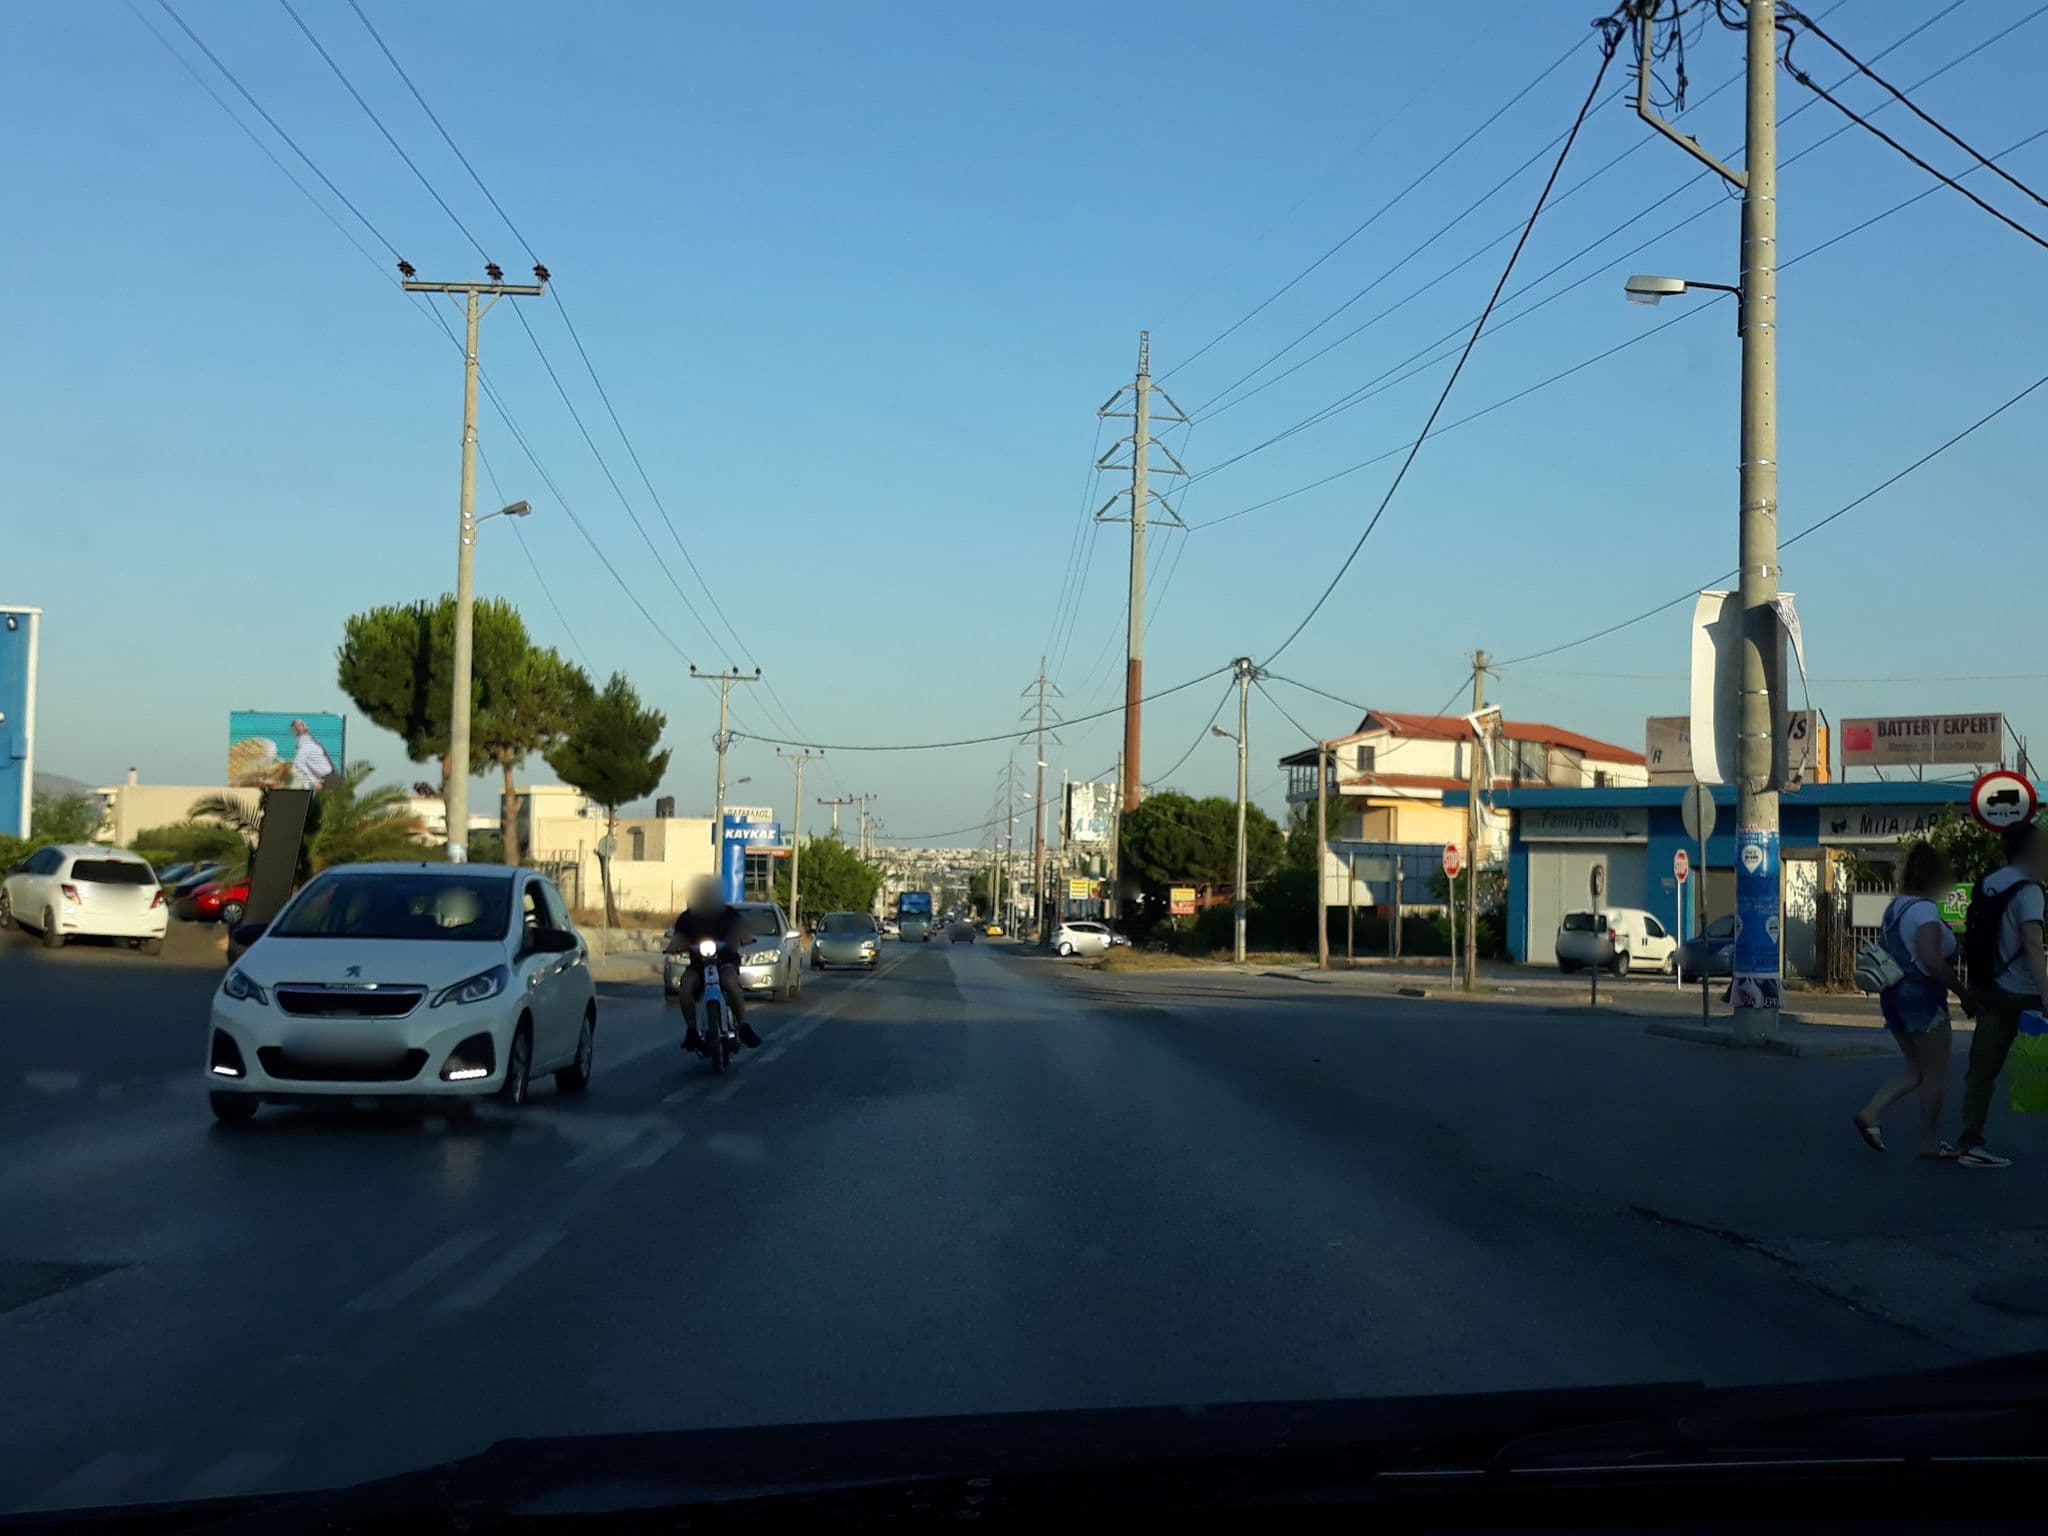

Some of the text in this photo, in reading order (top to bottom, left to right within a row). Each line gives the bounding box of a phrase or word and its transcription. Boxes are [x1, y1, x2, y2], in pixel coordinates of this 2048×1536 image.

[1877, 716, 1999, 737] BATTERY EXPERT
[1444, 851, 1460, 869] STOP
[1674, 858, 1688, 875] STOP
